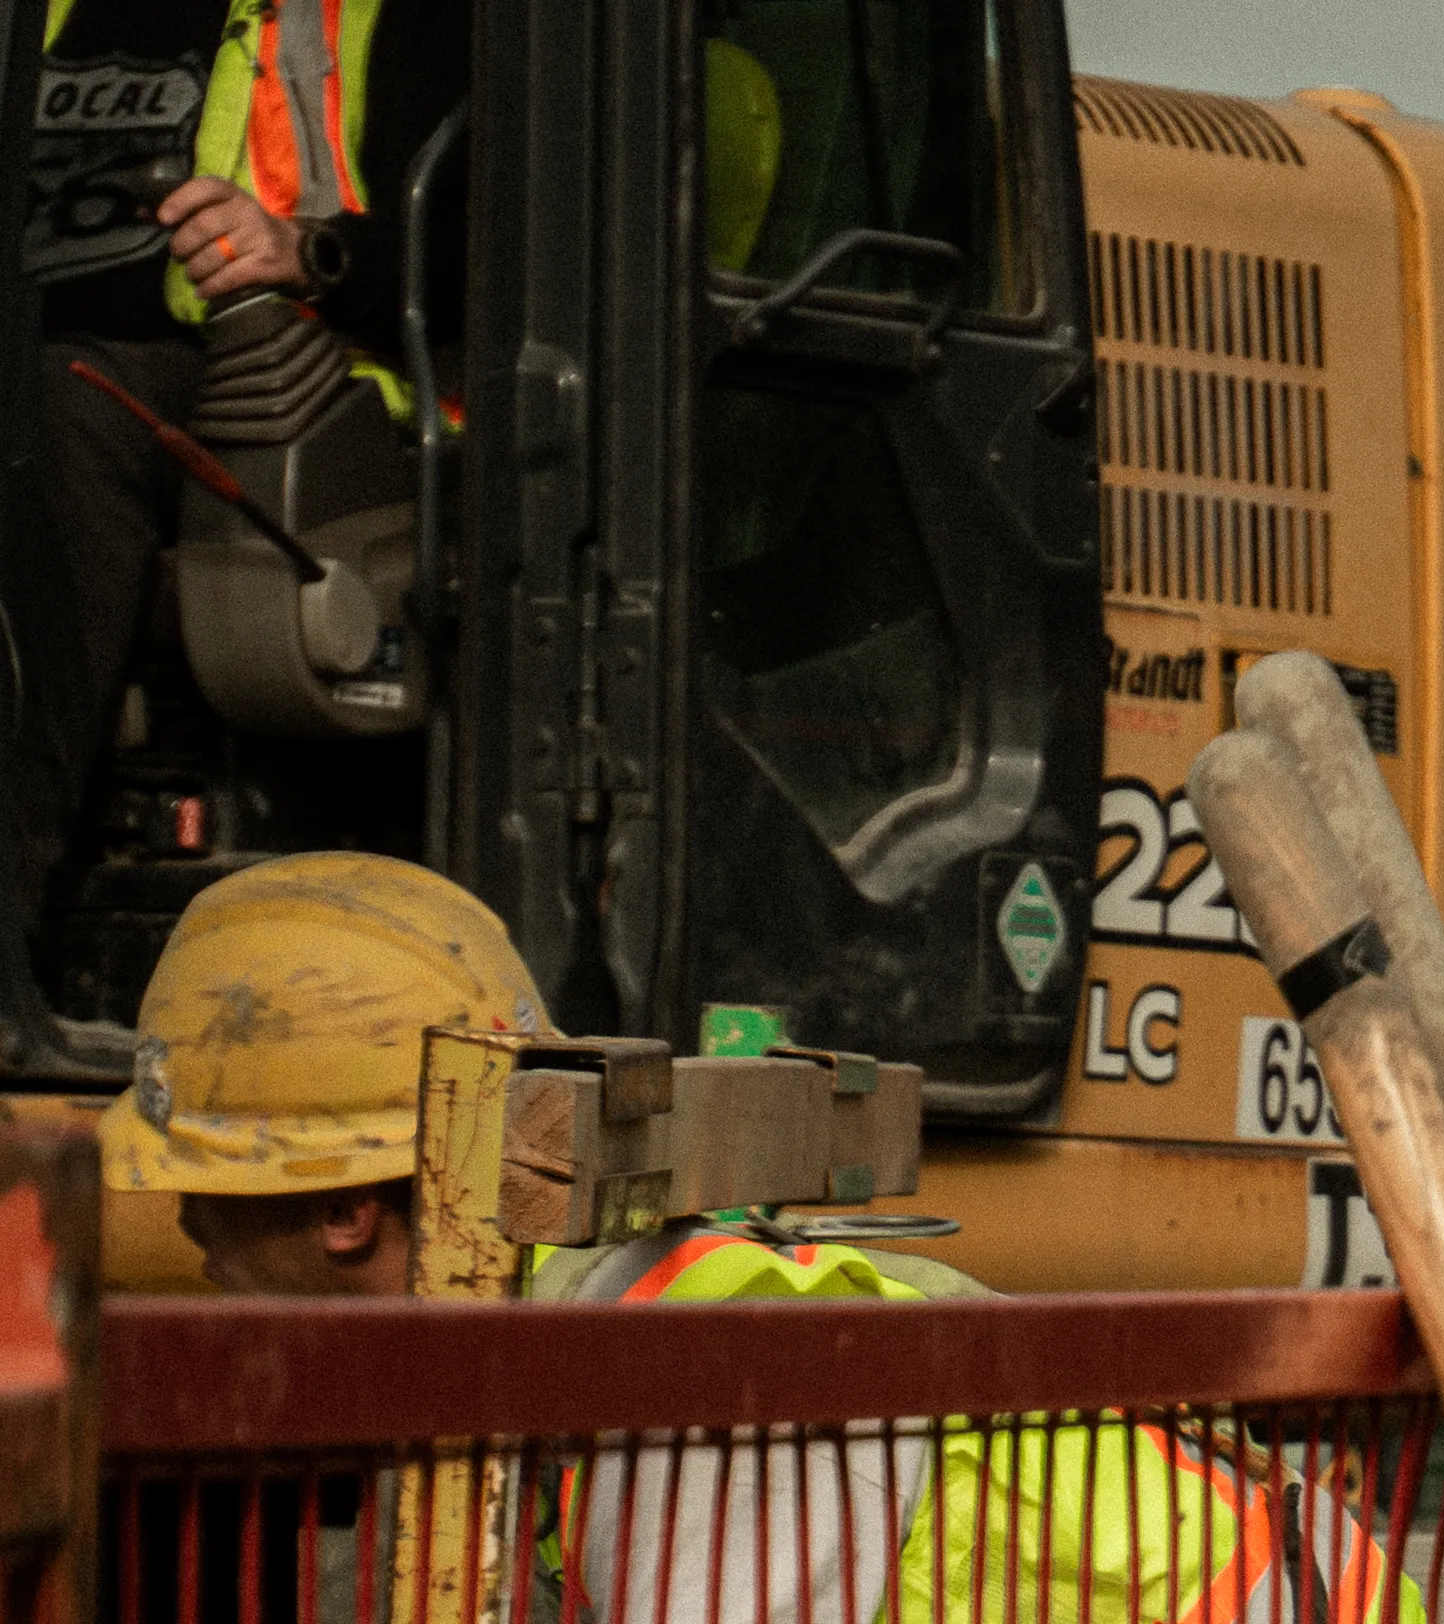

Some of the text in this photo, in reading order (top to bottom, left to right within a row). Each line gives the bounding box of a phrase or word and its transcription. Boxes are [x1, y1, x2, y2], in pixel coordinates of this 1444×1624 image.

[1103, 646, 1206, 703] randt
[1090, 778, 1262, 956] 22
[1084, 979, 1181, 1085] LC
[1258, 1022, 1345, 1138] 65
